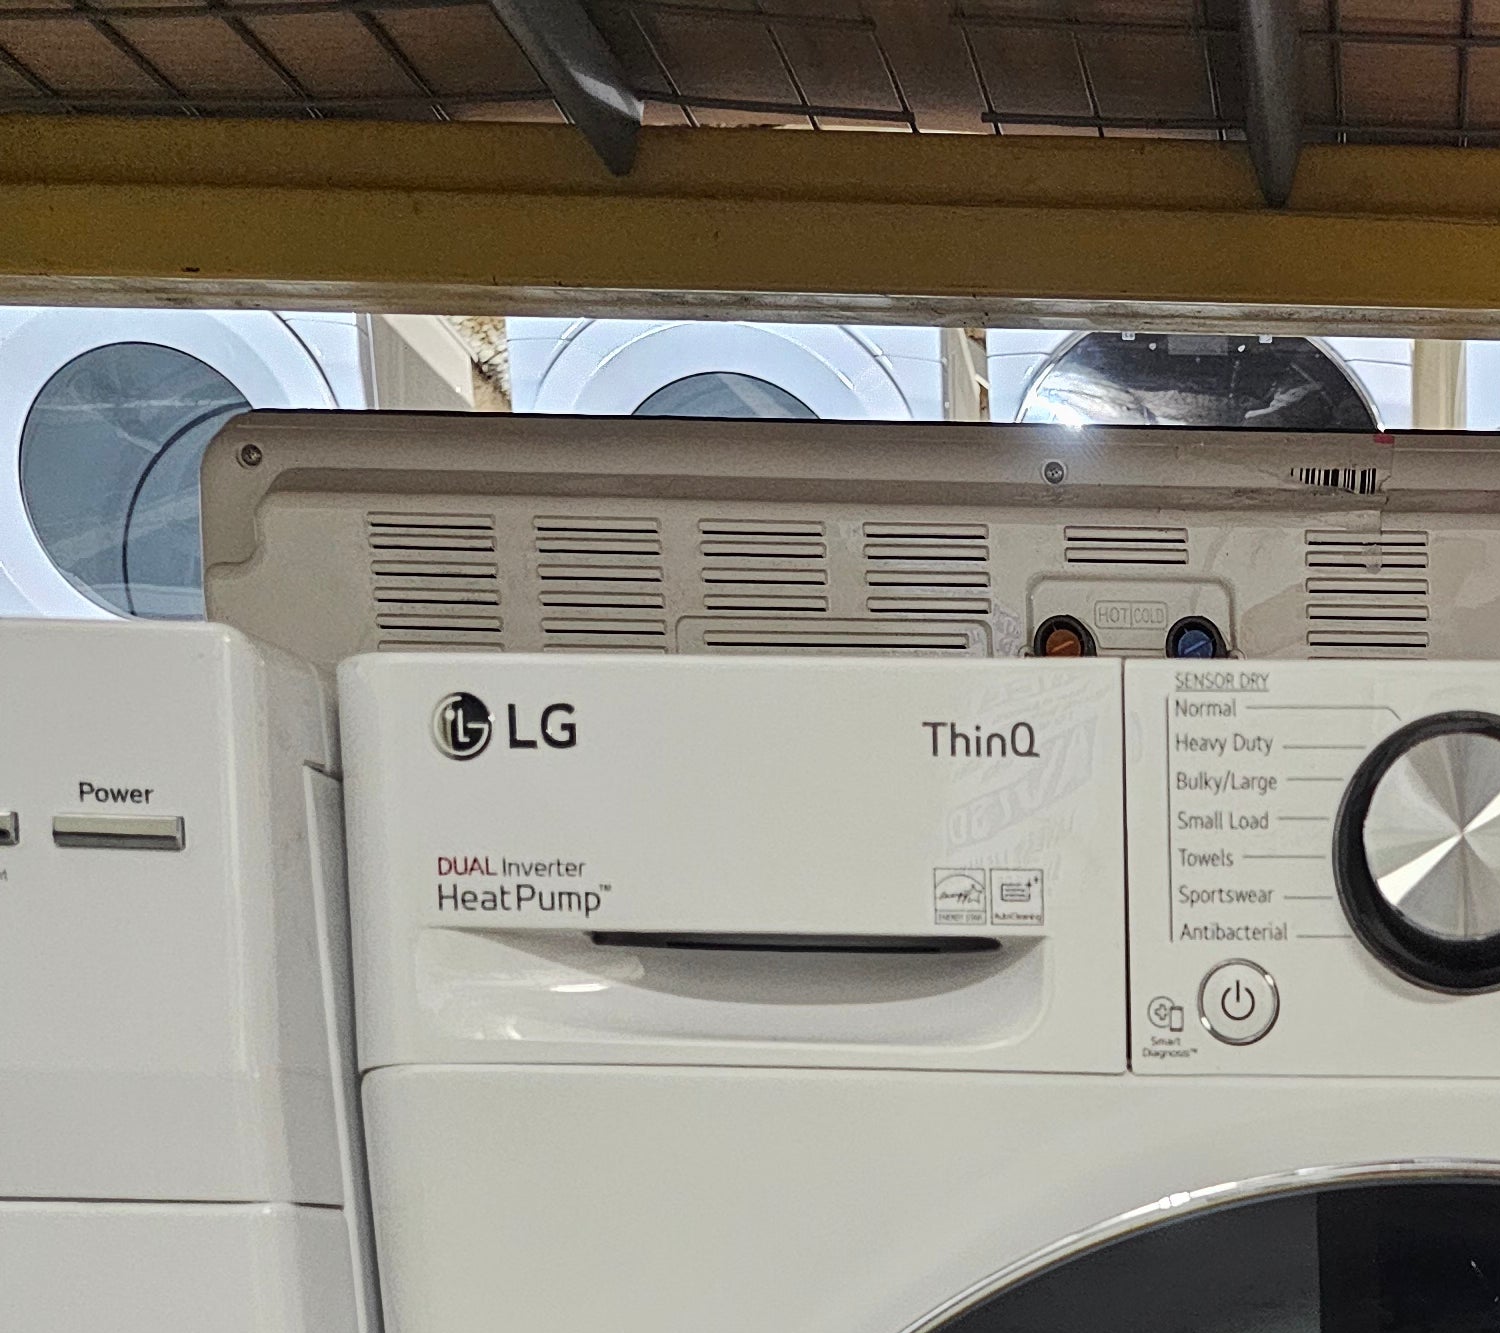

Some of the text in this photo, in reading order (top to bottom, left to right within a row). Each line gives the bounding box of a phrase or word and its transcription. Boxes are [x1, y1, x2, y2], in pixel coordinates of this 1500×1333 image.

[1098, 606, 1129, 624] HOT
[1134, 607, 1164, 624] COLD
[1175, 671, 1270, 689] SENSOR DRY
[1175, 698, 1236, 717] Normal
[507, 703, 577, 749] LG
[922, 721, 1041, 758] ThinQ
[1175, 732, 1273, 757] Heavy Duty
[78, 781, 154, 804] Power
[1176, 770, 1278, 796] Bulky/Large
[1177, 810, 1269, 830] Small Load
[437, 856, 587, 877] DUAL Inverter
[1177, 847, 1234, 867] Towels
[1178, 884, 1275, 908] Sportswear
[1180, 921, 1288, 941] Antibacterial
